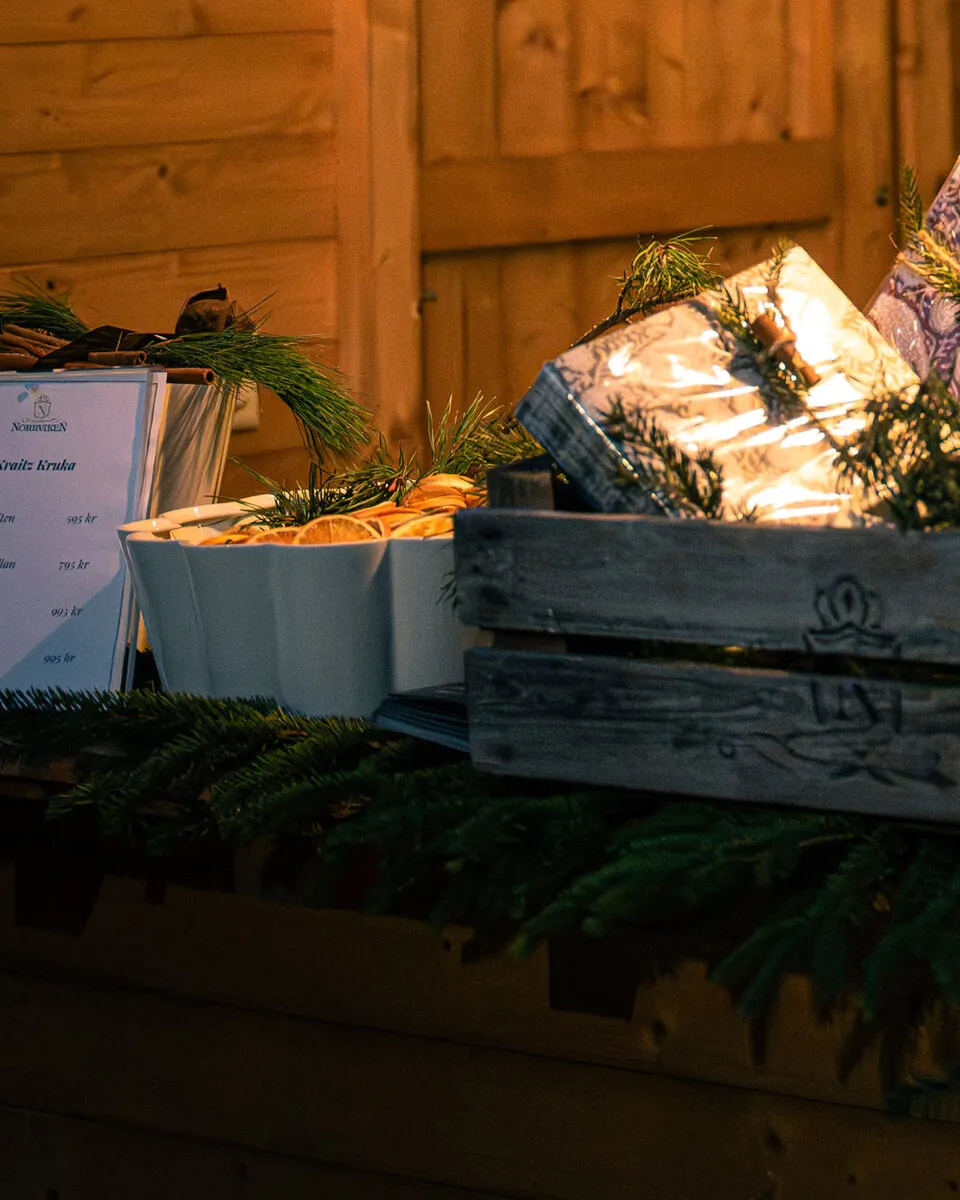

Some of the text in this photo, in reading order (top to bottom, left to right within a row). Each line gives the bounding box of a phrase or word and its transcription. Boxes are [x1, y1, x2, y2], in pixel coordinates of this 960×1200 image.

[36, 458, 77, 471] Kruka
[84, 512, 98, 525] kr
[58, 560, 75, 571] 795
[76, 558, 90, 570] kr
[70, 605, 84, 617] kr
[62, 651, 76, 664] kr
